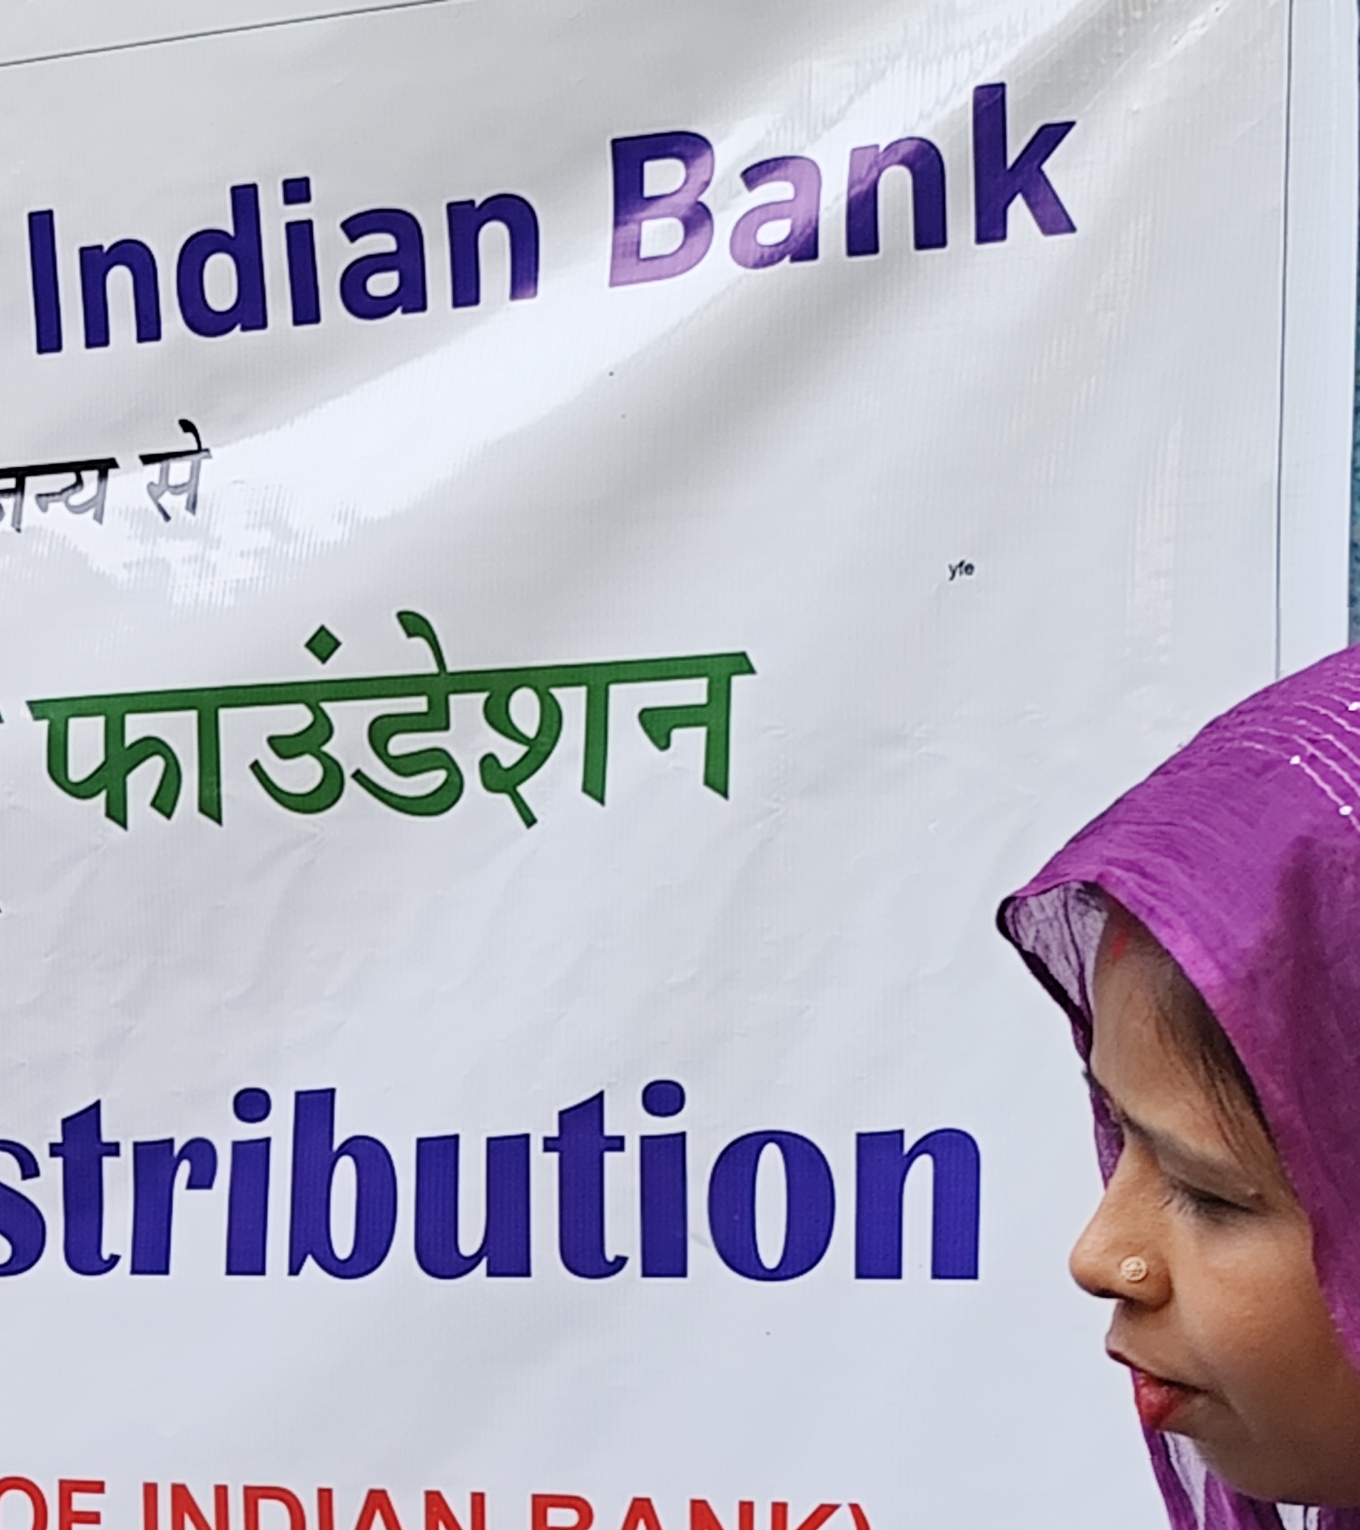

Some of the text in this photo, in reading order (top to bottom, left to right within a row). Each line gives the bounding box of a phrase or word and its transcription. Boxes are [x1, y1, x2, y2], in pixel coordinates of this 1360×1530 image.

[26, 80, 1079, 357] Indian Bank
[137, 417, 213, 523] से
[24, 608, 759, 833] फाउंडेशन
